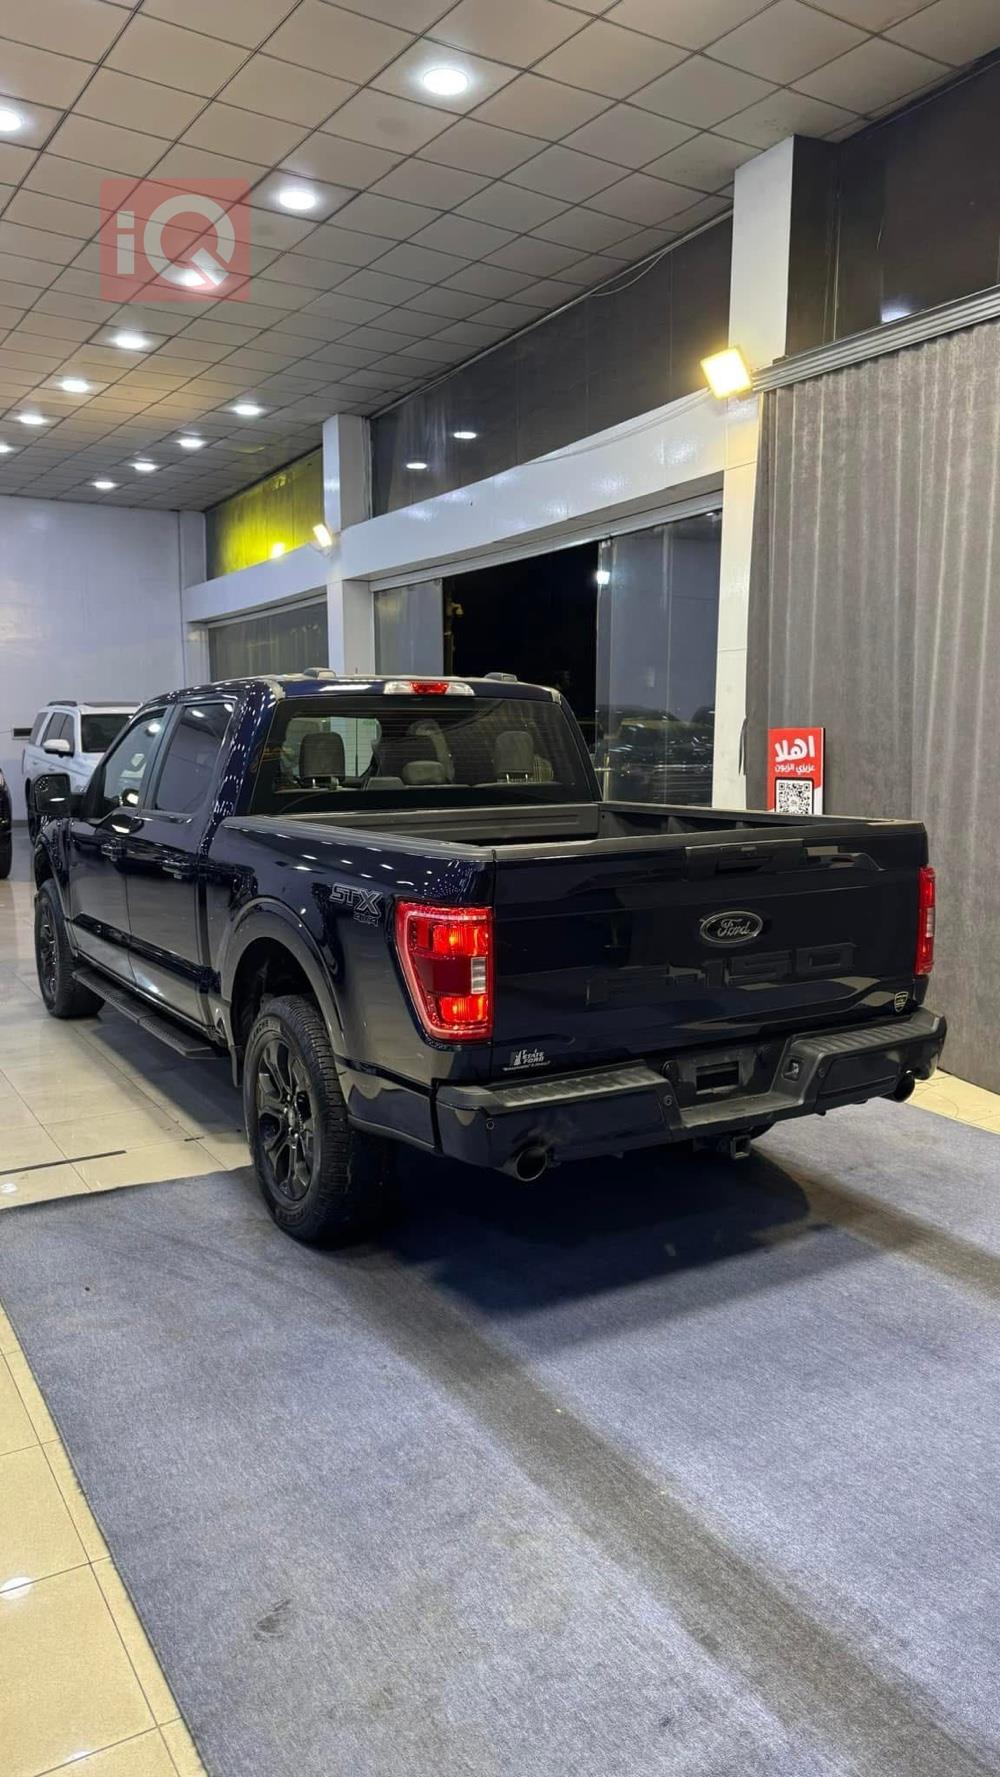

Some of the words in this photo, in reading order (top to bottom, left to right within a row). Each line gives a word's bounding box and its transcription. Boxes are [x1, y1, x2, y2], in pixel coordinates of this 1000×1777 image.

[775, 735, 815, 762] اهلا
[330, 883, 382, 915] STX
[717, 919, 751, 936] Ford
